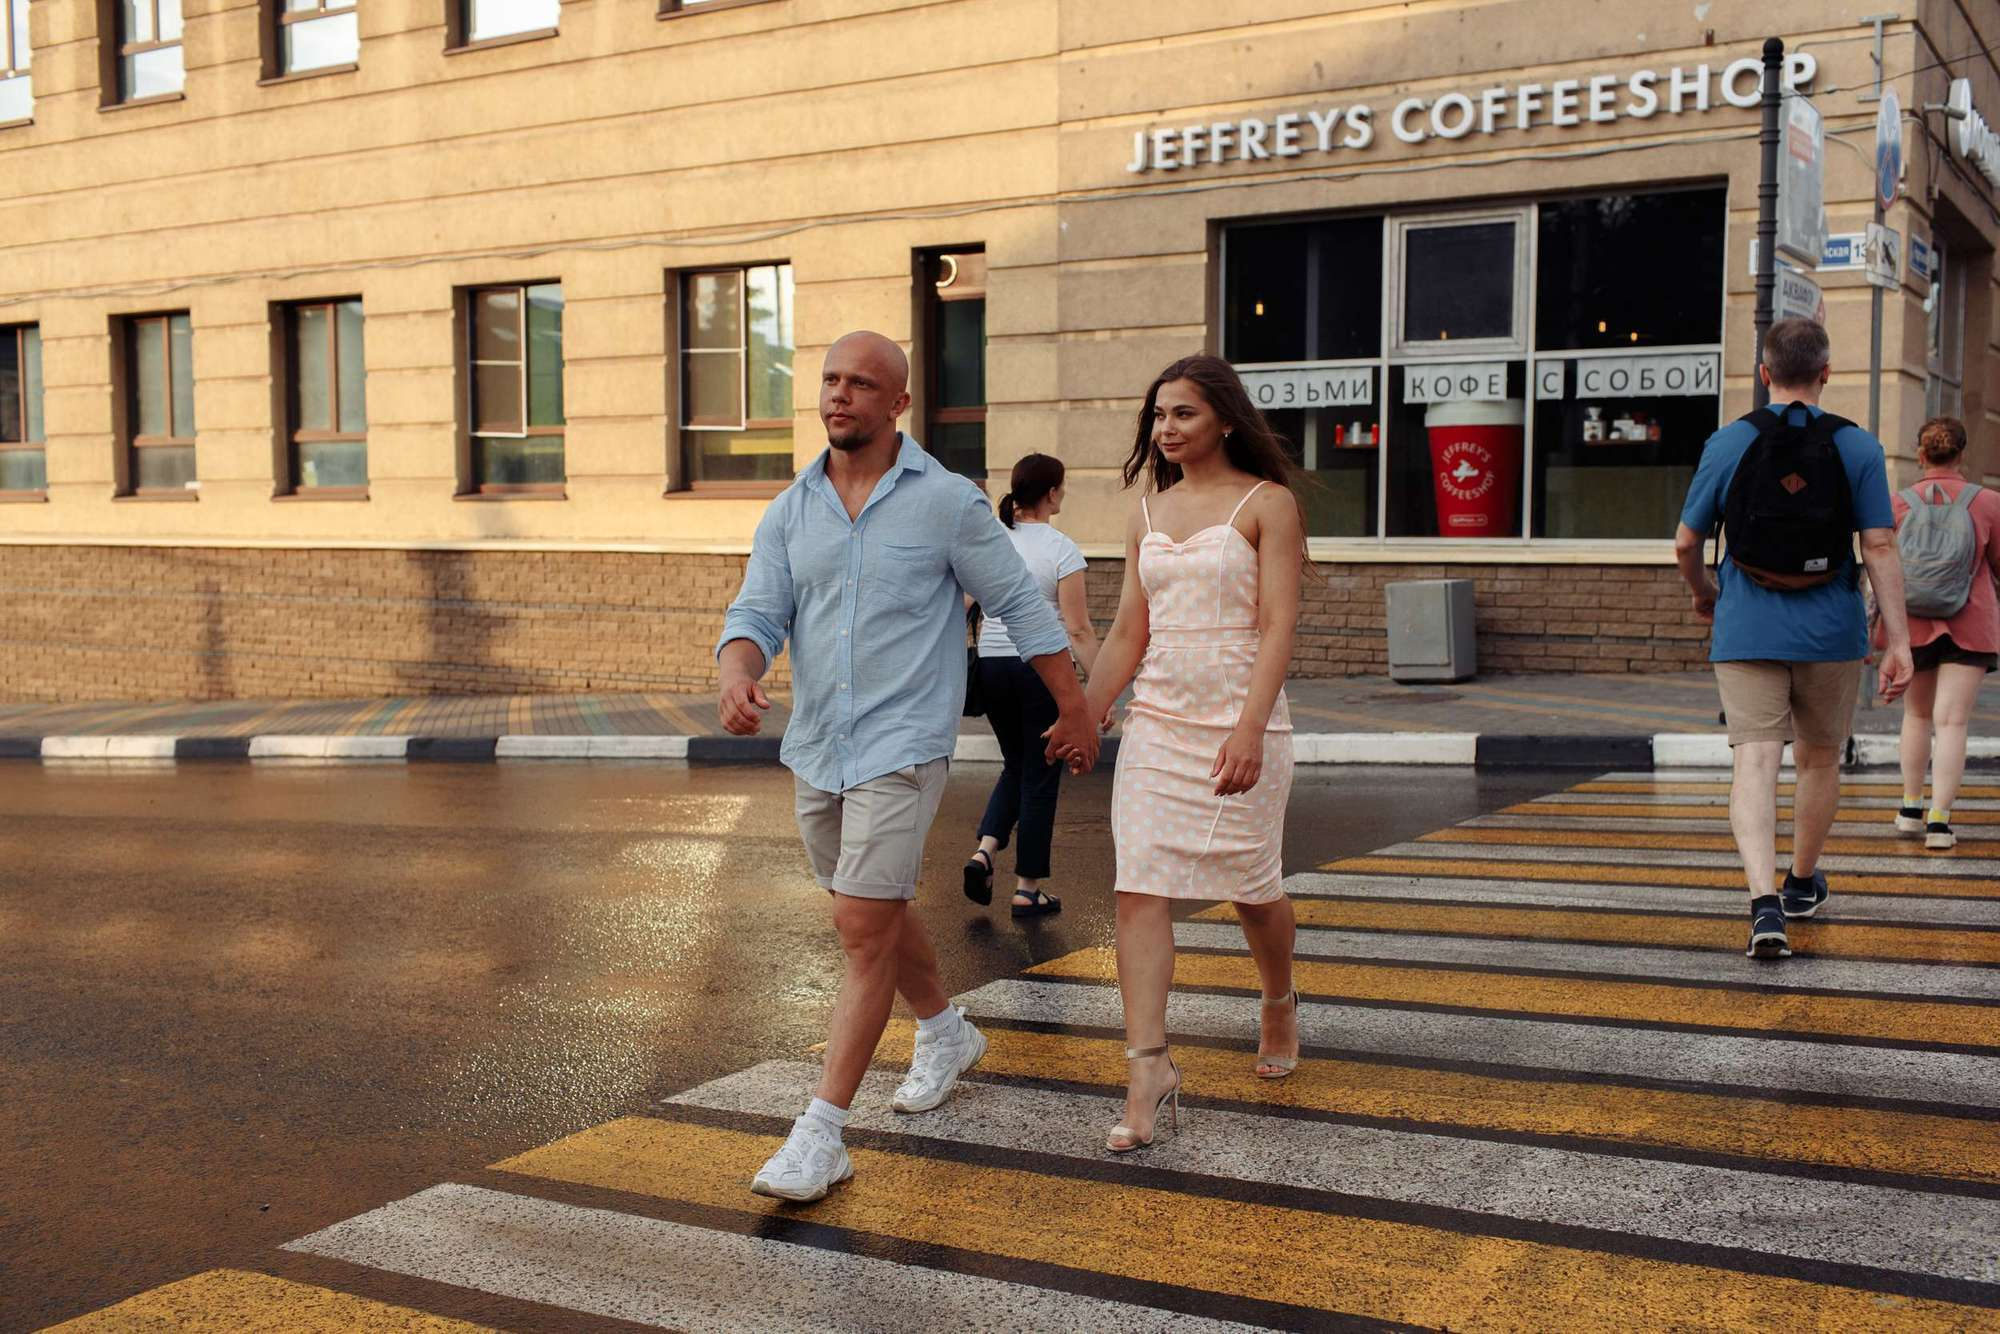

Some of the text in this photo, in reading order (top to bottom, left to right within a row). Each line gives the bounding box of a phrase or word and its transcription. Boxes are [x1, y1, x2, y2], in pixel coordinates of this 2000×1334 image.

[1126, 52, 1818, 173] JEFFREYS COFFEESHOP
[1412, 374, 1500, 397] КОФЕ
[1542, 372, 1559, 393] С
[1584, 361, 1713, 392] СОБОЙ
[1440, 471, 1496, 500] COFFEESHOP
